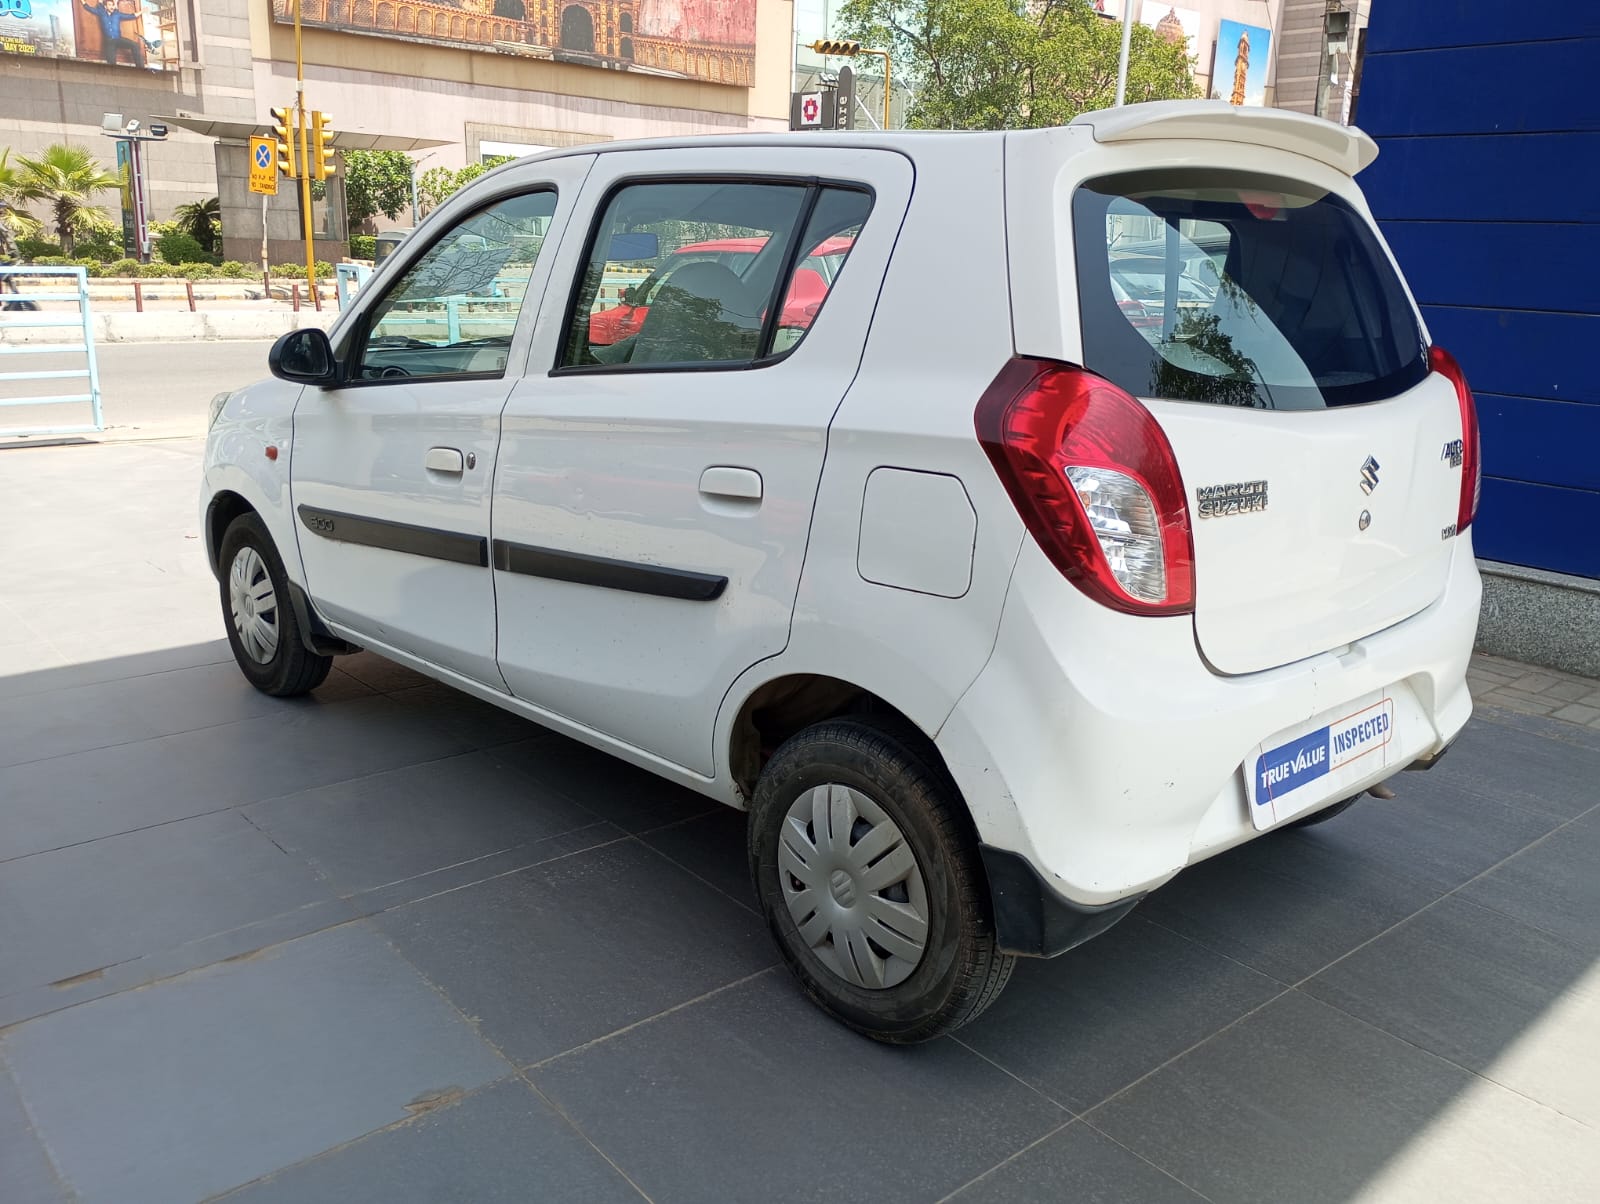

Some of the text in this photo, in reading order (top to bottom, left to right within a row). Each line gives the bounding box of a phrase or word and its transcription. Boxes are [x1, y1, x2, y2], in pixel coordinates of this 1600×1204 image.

[4, 42, 17, 52] MAY
[838, 96, 847, 130] are
[1196, 480, 1268, 501] MARUTI
[1198, 493, 1268, 519] SUZUKI
[1261, 712, 1389, 789] TRUE VALUE INSPECTED
